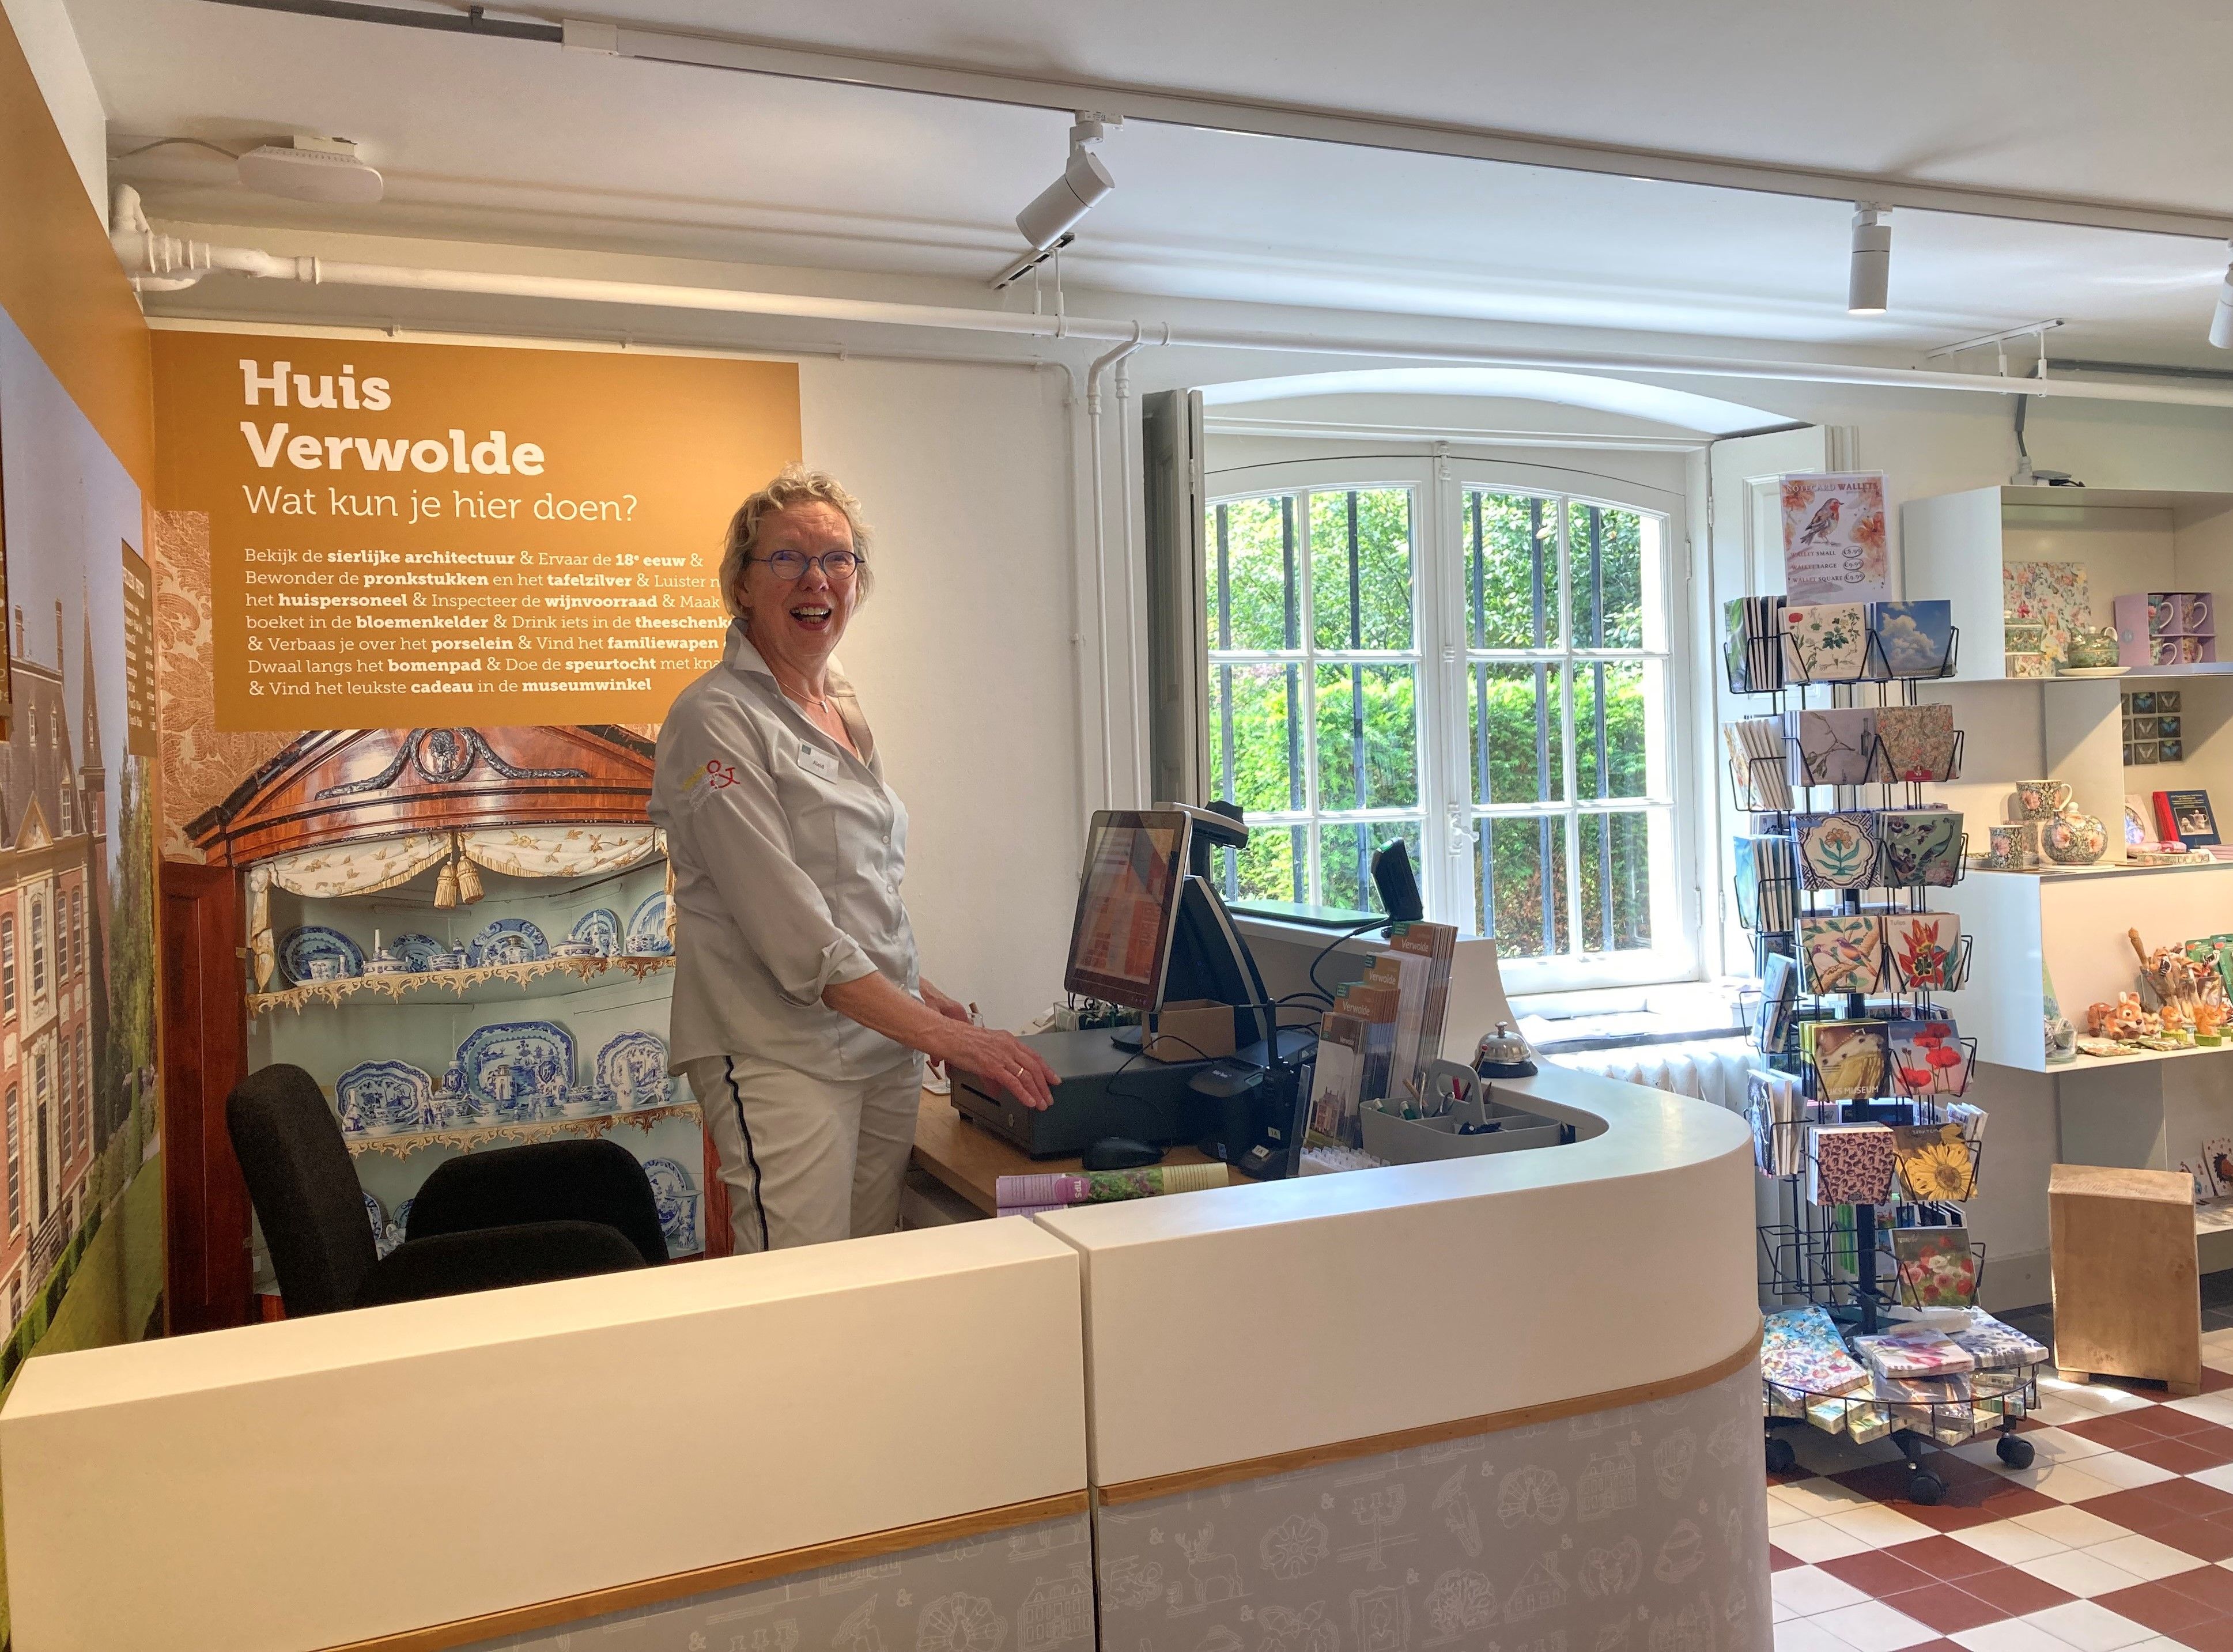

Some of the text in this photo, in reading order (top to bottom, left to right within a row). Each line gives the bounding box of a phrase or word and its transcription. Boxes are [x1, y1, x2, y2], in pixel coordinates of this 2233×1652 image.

[239, 359, 391, 411] Huis
[240, 421, 545, 476] Verwolde
[242, 485, 637, 524] Wat kun je hier doen?
[244, 548, 298, 565] Bekijk
[302, 549, 323, 562] de
[327, 549, 400, 566] sierlijke
[405, 550, 516, 565] architectuur
[520, 550, 534, 565] &
[538, 552, 589, 566] Ervaar
[592, 553, 611, 566] de
[643, 557, 686, 567] eeuw
[690, 553, 704, 567] &
[245, 570, 334, 585] Bewonder
[338, 572, 359, 585] de
[363, 572, 489, 588] pronkstukken
[493, 576, 514, 586] en
[517, 573, 544, 586] het
[547, 573, 632, 587] tafelzilver
[636, 573, 650, 587] &
[654, 574, 706, 588] Luister
[245, 592, 721, 611] het huispersoneel & Inspecteer de wijnvoorraad & Maak
[245, 615, 305, 629] boeket
[309, 615, 327, 629] in
[331, 615, 352, 629] de
[355, 615, 489, 629] bloemenkelder
[493, 614, 508, 629] &
[512, 615, 558, 629] Drink
[561, 615, 588, 629] iets
[592, 615, 609, 629] in
[612, 615, 631, 629] de
[248, 636, 263, 651] &
[267, 637, 335, 651] Verbaas
[339, 637, 354, 654] je
[359, 640, 396, 651] over
[400, 637, 428, 650] het
[430, 637, 513, 653] porselein
[518, 635, 532, 649] &
[535, 637, 575, 649] Vind
[577, 637, 604, 649] het
[607, 636, 719, 652] familiewapen
[248, 659, 302, 673] Dwaal
[305, 659, 352, 676] langs
[356, 659, 384, 672] het
[387, 658, 482, 675] bomenpad
[486, 656, 501, 671] &
[505, 658, 538, 671] Doe
[542, 657, 561, 671] de
[565, 657, 656, 674] speurtocht
[660, 658, 690, 670] met
[249, 678, 652, 695] & Vind het leukste cadeau in de museumwinkel
[1401, 938, 1429, 952] Verwolde
[1369, 970, 1396, 985] Verwolde
[1343, 999, 1370, 1014] Verwolde
[1844, 1086, 1879, 1095] MUSEUM
[1074, 1180, 1082, 1199] TIPS
